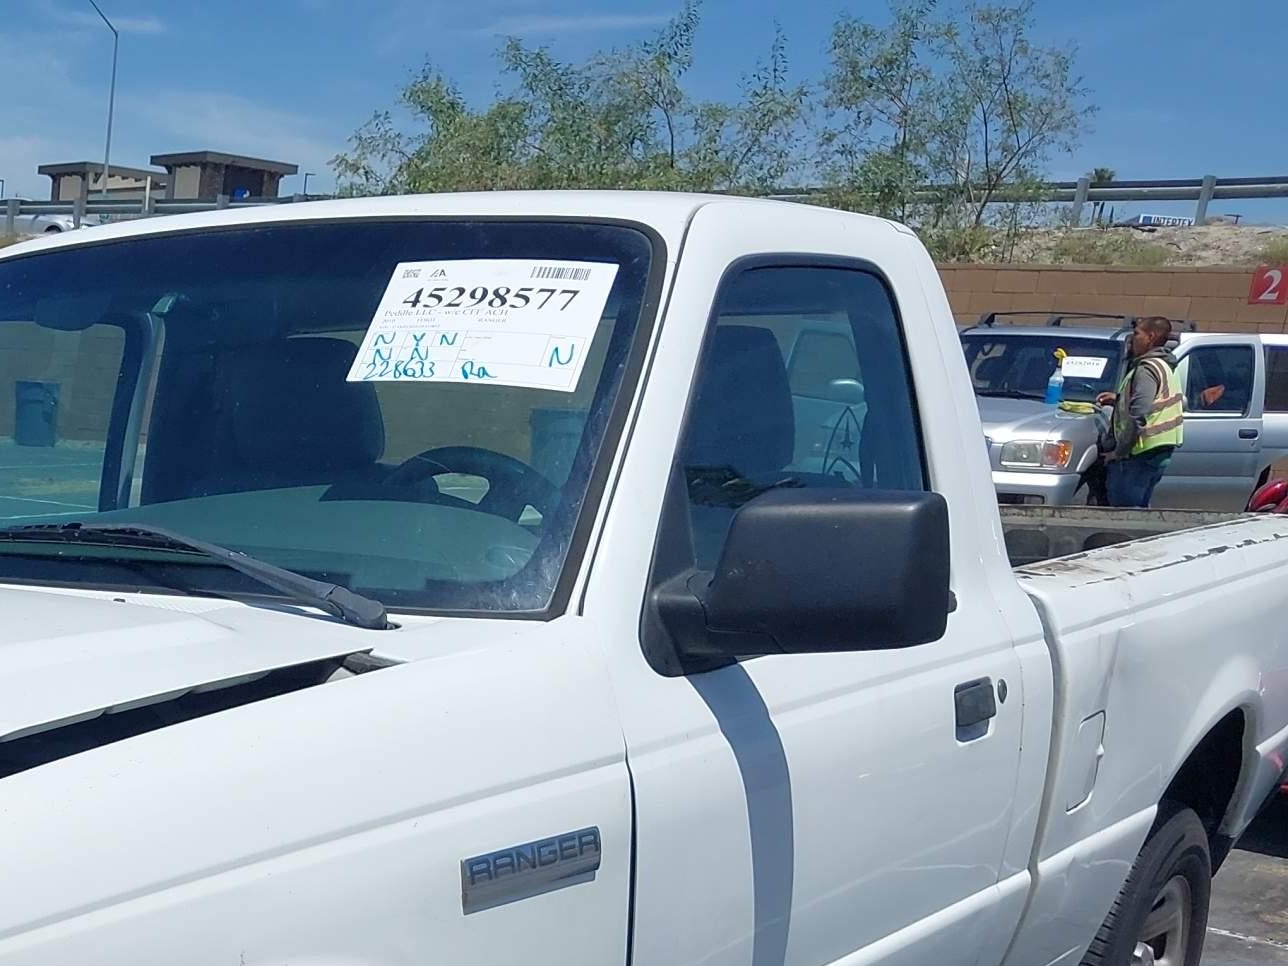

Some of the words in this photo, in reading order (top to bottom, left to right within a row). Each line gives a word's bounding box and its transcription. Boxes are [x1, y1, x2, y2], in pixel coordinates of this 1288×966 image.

[402, 286, 581, 311] 45298577
[1258, 269, 1282, 301] 2
[440, 332, 458, 346] N
[468, 833, 600, 886] RANGER
